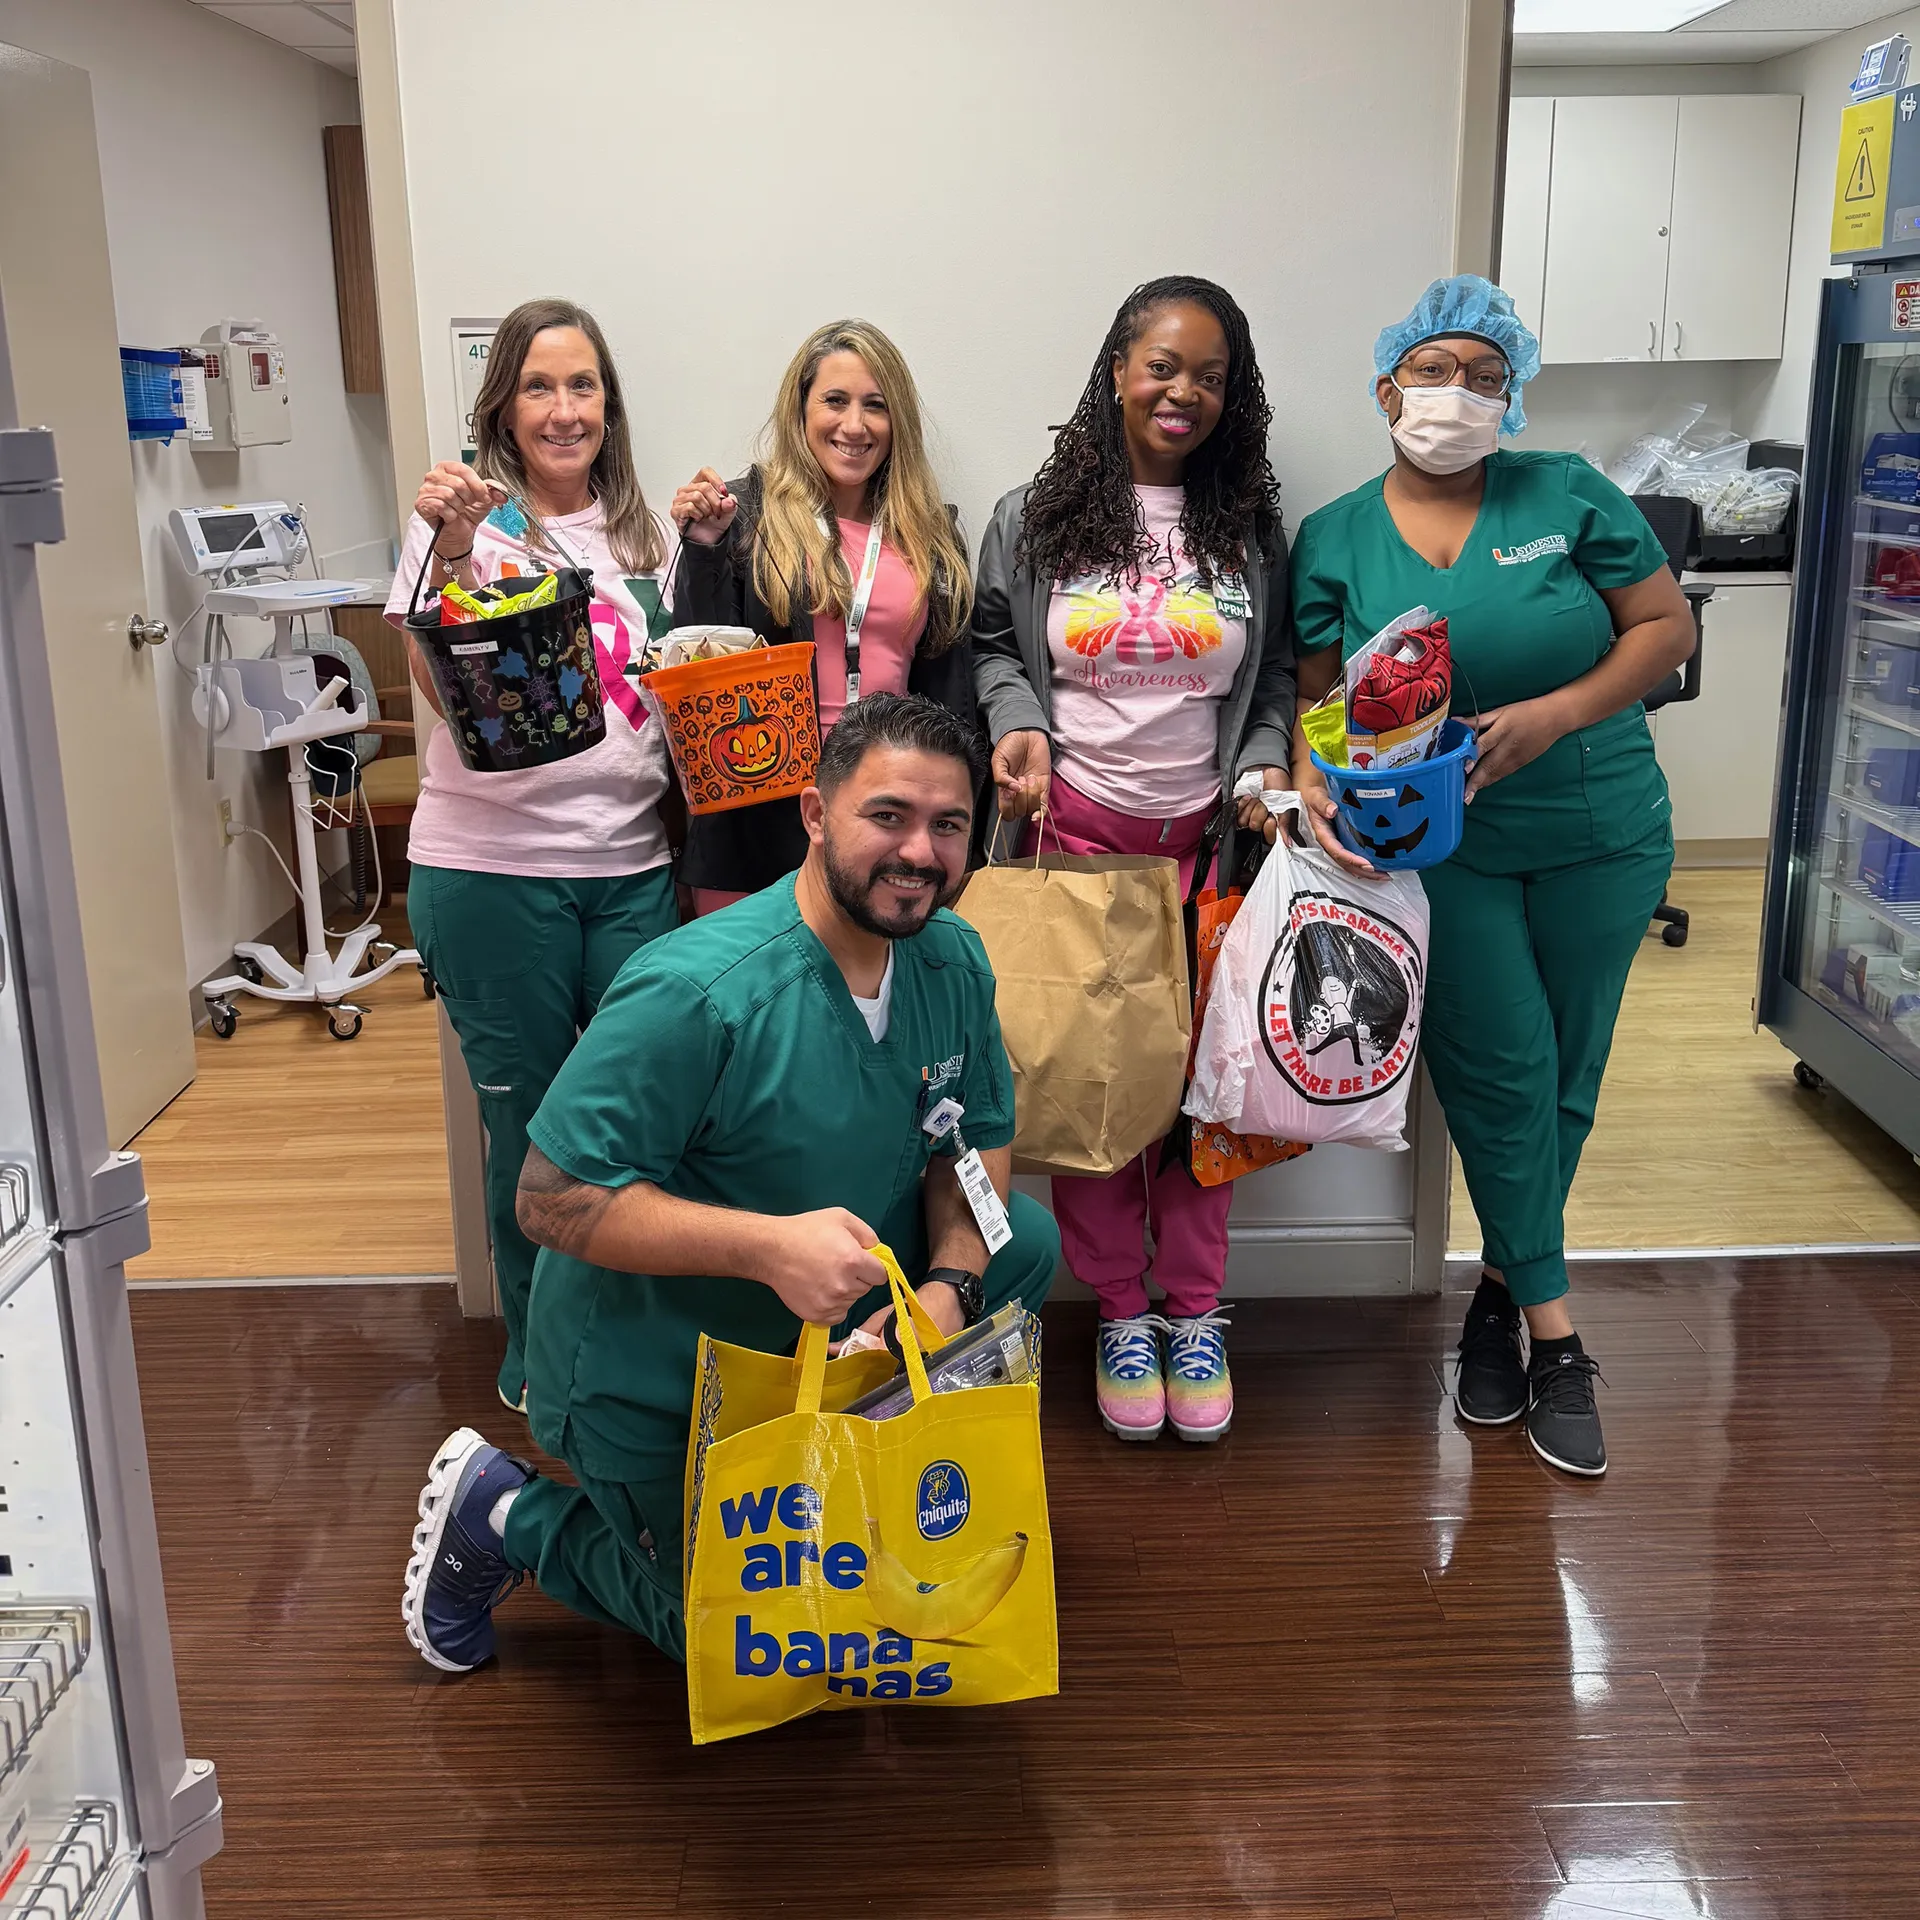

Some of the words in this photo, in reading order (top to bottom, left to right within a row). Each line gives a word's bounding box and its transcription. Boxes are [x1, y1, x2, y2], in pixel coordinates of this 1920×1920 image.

[1858, 126, 1874, 135] CAUTION
[1517, 535, 1567, 554] SYLVESTER
[1218, 601, 1244, 618] APRN
[1074, 658, 1211, 693] Awareness
[1270, 1003, 1293, 1044] LET
[1282, 1047, 1332, 1095] THERE
[1338, 1076, 1364, 1094] BE
[1371, 1038, 1410, 1087] ART!
[720, 1483, 822, 1539] we
[918, 1499, 968, 1529] Chiquita
[741, 1540, 868, 1592] are
[735, 1615, 913, 1678] bana
[827, 1662, 953, 1699] nas
